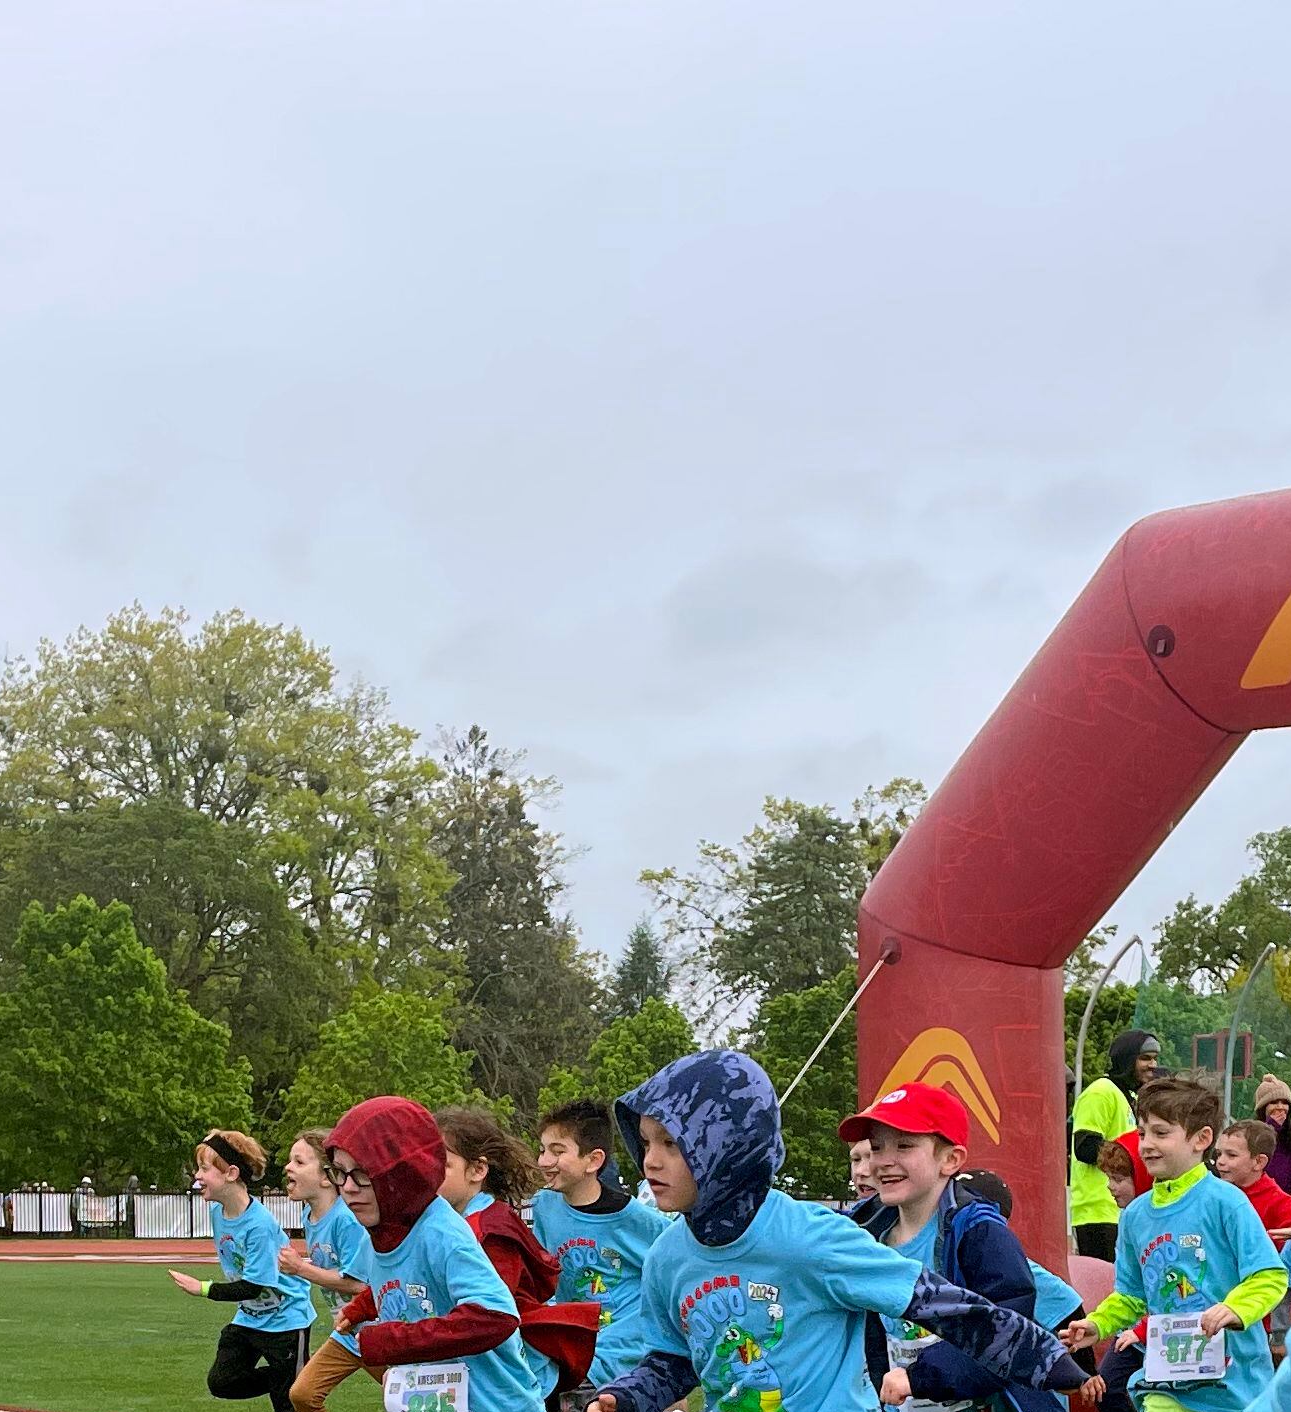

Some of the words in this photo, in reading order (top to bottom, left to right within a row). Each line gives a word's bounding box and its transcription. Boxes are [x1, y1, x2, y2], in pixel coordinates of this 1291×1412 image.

[1166, 1334, 1207, 1363] 877
[417, 1374, 445, 1386] AWESOME
[446, 1372, 462, 1384] 3000
